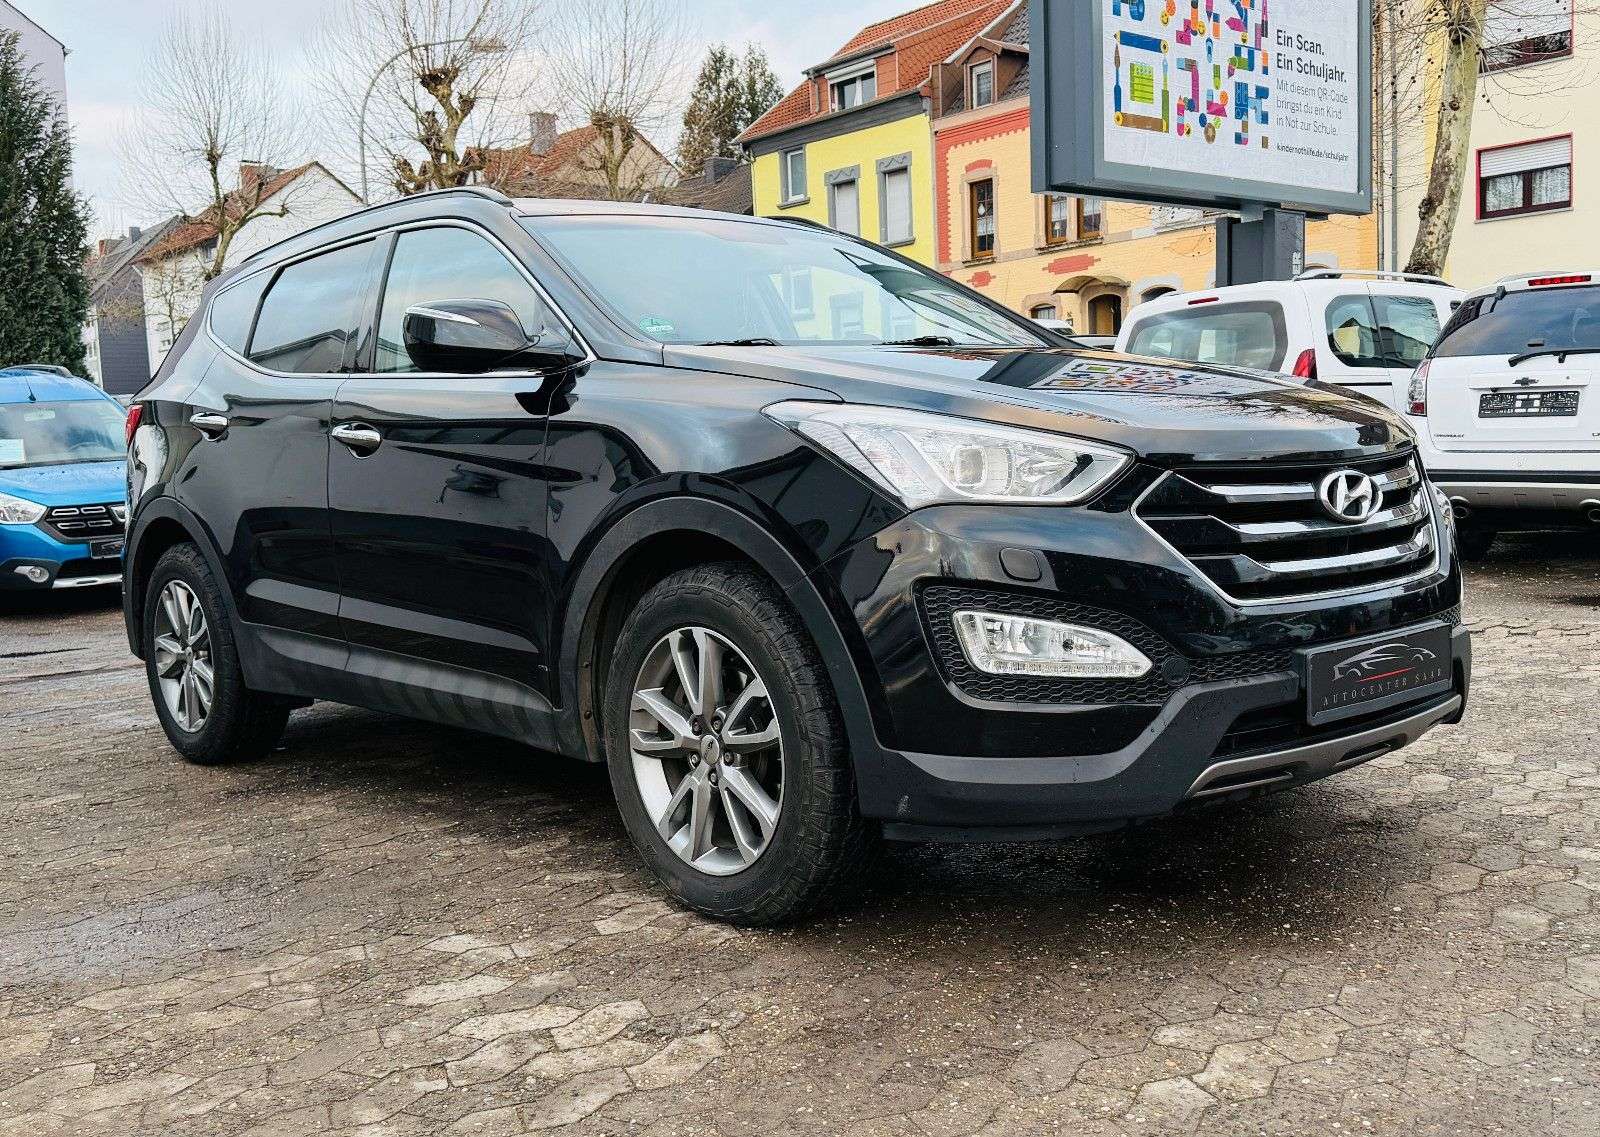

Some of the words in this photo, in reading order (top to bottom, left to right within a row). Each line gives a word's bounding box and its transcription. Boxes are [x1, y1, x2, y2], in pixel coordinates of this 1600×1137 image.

[1276, 29, 1293, 48] Ein
[1296, 34, 1325, 56] Scan.
[1276, 52, 1293, 71] Ein
[1296, 56, 1347, 83] Schuljahr.
[1276, 77, 1289, 93] Mit
[1290, 81, 1316, 98] diesem
[1276, 95, 1302, 114] bringst
[1303, 102, 1313, 115] du
[1314, 105, 1326, 117] ein
[1326, 105, 1343, 120] Kind
[1285, 115, 1299, 129] Not
[1300, 121, 1312, 132] zur
[1313, 120, 1339, 136] Schule.
[1323, 678, 1408, 706] AUTOCENTER
